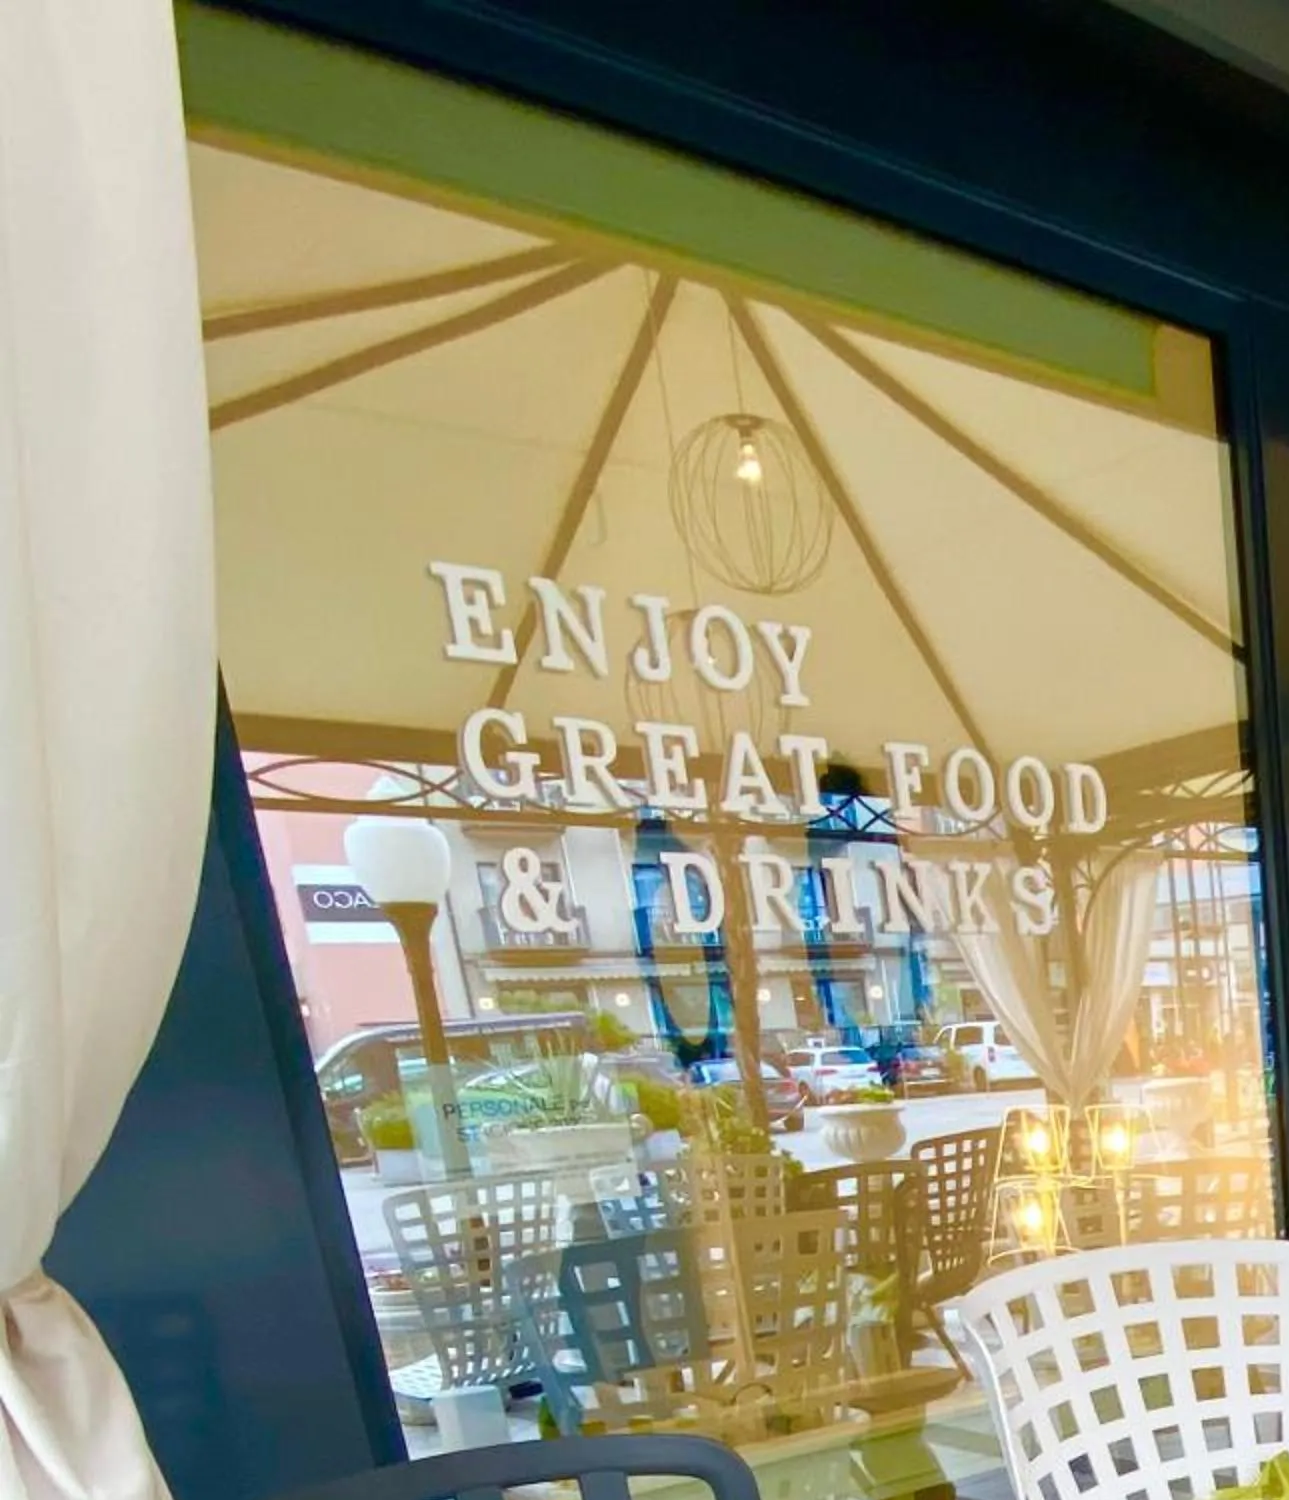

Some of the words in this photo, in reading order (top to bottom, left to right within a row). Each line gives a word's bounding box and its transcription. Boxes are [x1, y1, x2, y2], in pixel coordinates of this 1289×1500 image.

[428, 562, 812, 706] ENJOY
[458, 706, 828, 822] GREAT
[882, 740, 1108, 837] FOOD
[499, 844, 579, 934] &
[658, 848, 1058, 937] DRINKS
